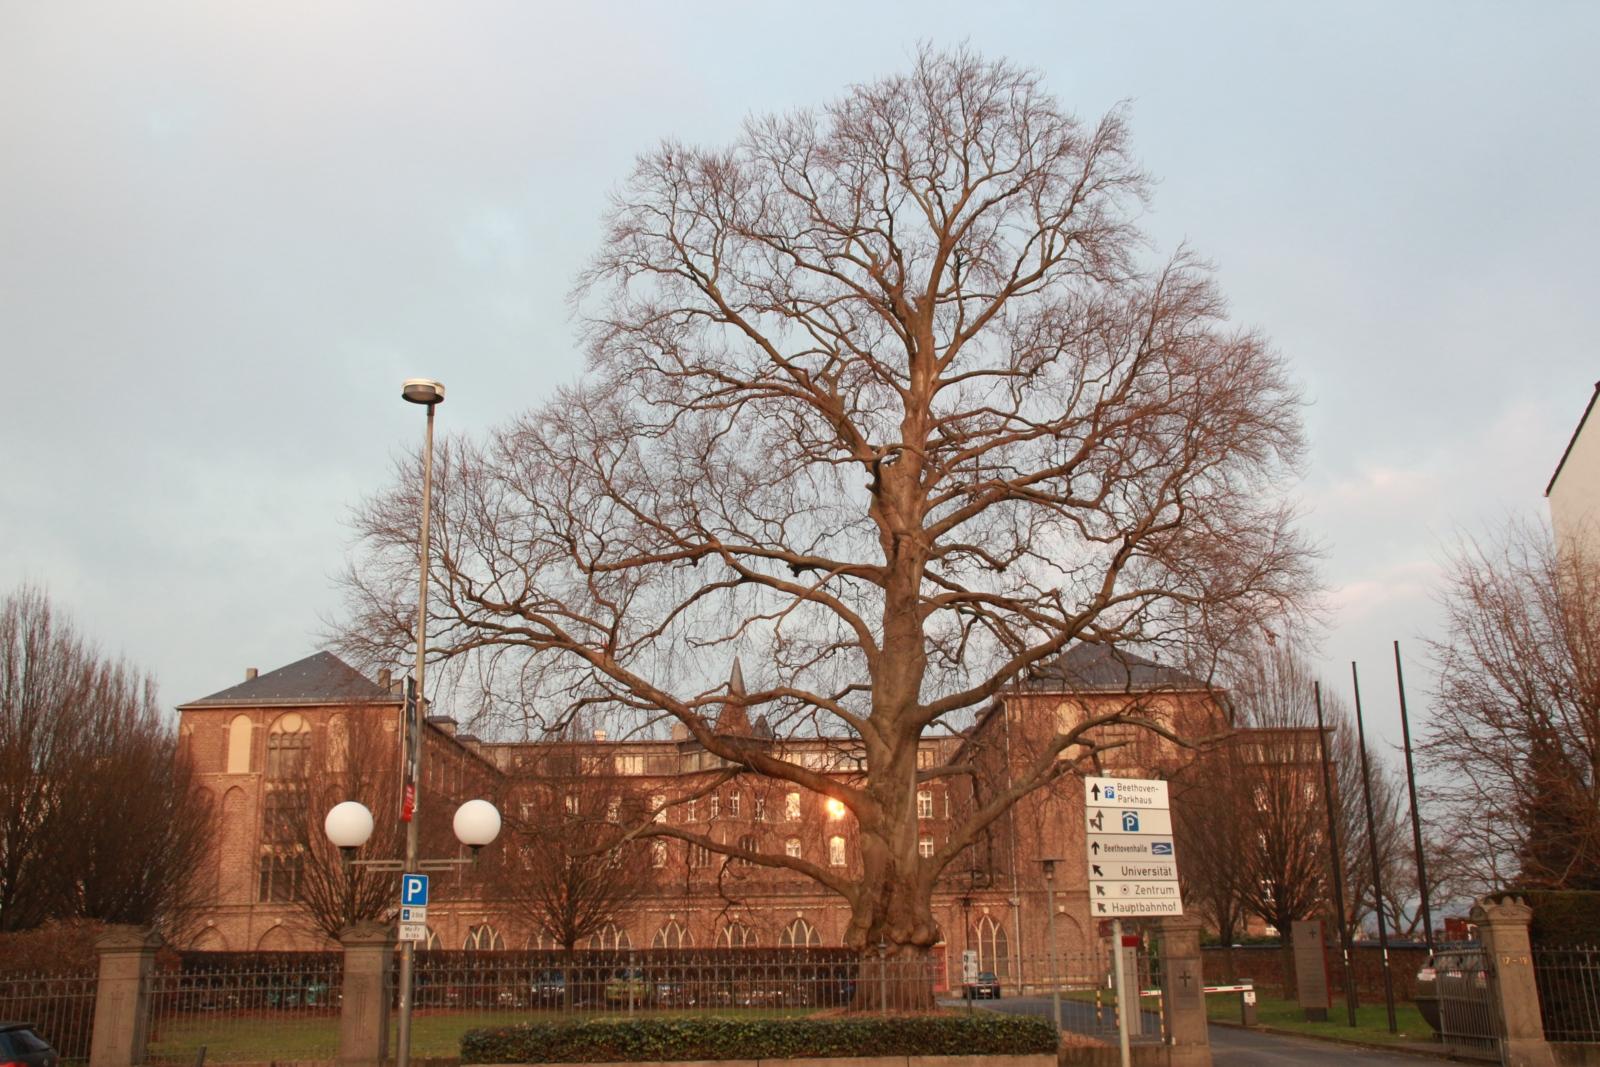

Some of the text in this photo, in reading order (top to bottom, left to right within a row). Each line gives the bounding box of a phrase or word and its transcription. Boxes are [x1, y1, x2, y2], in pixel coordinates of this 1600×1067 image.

[1117, 783, 1159, 792] Beethoven-
[1118, 795, 1152, 804] Parkhaus
[1126, 817, 1135, 831] P
[1103, 844, 1147, 853] Beethovenhalle
[1121, 866, 1172, 877] Universität
[408, 879, 422, 902] P
[1135, 885, 1175, 895] Zentrum
[1112, 902, 1177, 914] Hauptbahnhof
